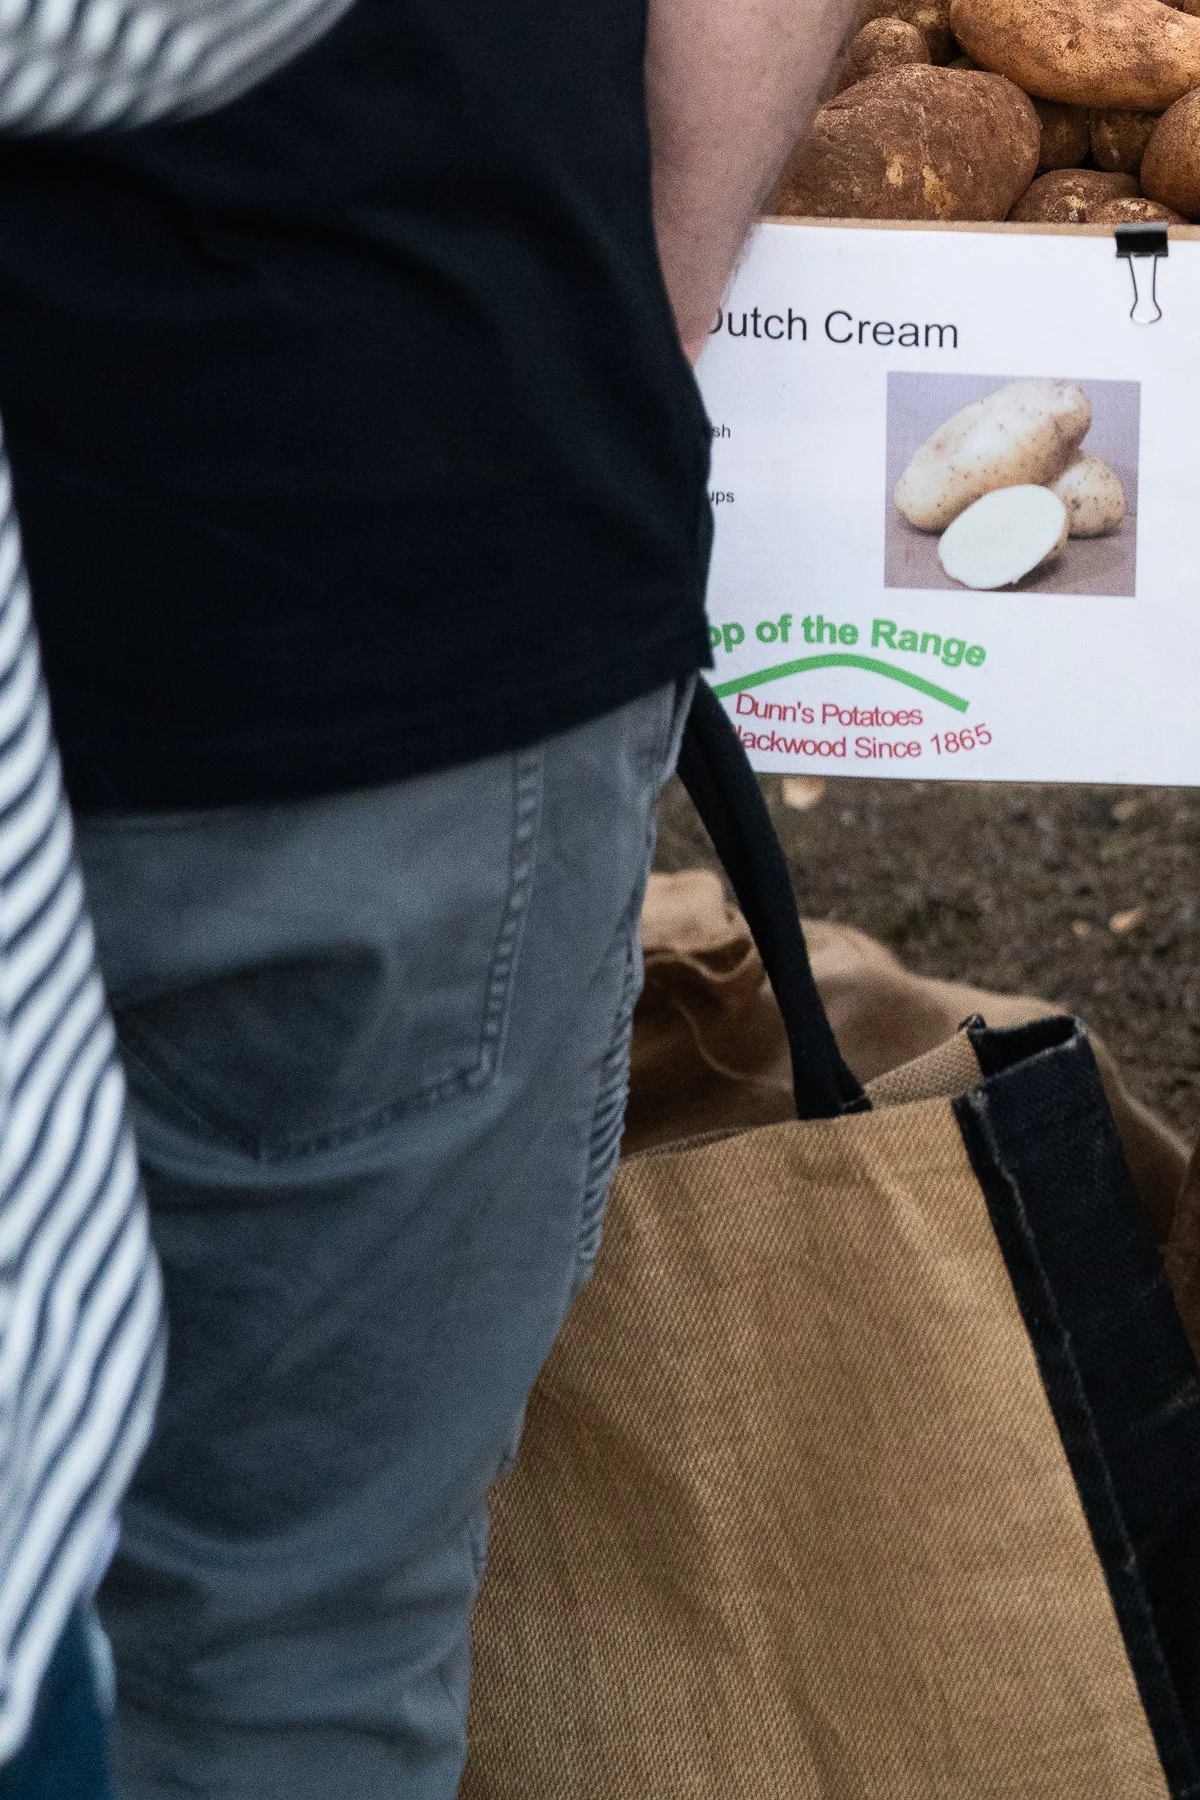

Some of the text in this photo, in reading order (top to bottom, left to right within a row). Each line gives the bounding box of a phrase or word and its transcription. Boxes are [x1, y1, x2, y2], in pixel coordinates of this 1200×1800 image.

[824, 310, 958, 349] Cream
[708, 613, 987, 668] op of the Range
[735, 691, 923, 727] Dunn's Potatoes
[735, 723, 993, 759] lackwood Since 1865
